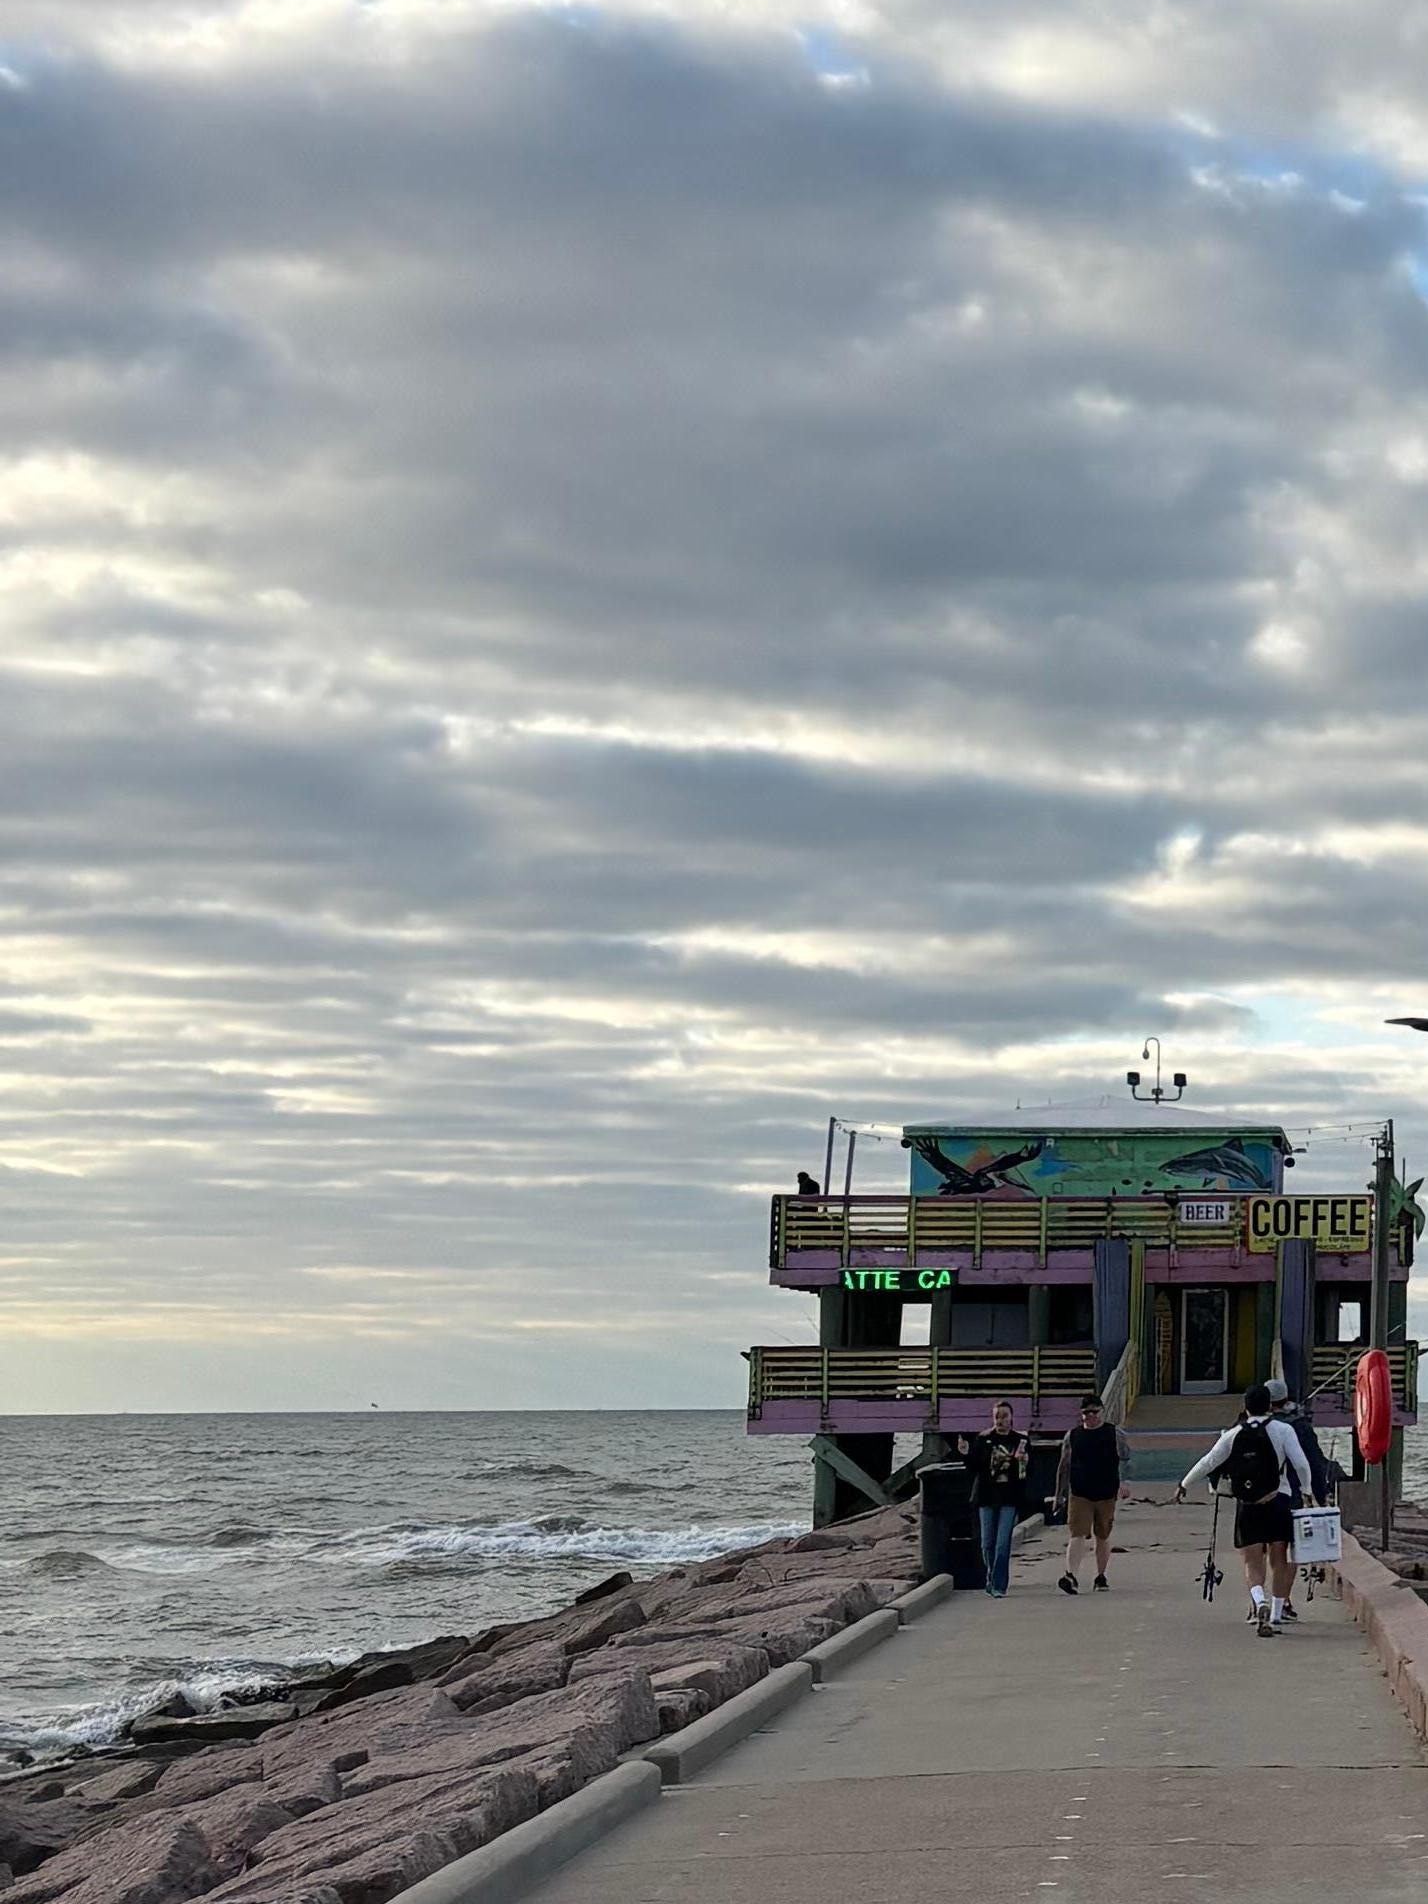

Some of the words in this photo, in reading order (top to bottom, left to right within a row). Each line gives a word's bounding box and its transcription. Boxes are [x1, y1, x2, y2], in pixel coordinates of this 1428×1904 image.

[1185, 1204, 1225, 1221] BEER
[1252, 1199, 1367, 1237] COFFEE
[918, 1270, 951, 1290] CA
